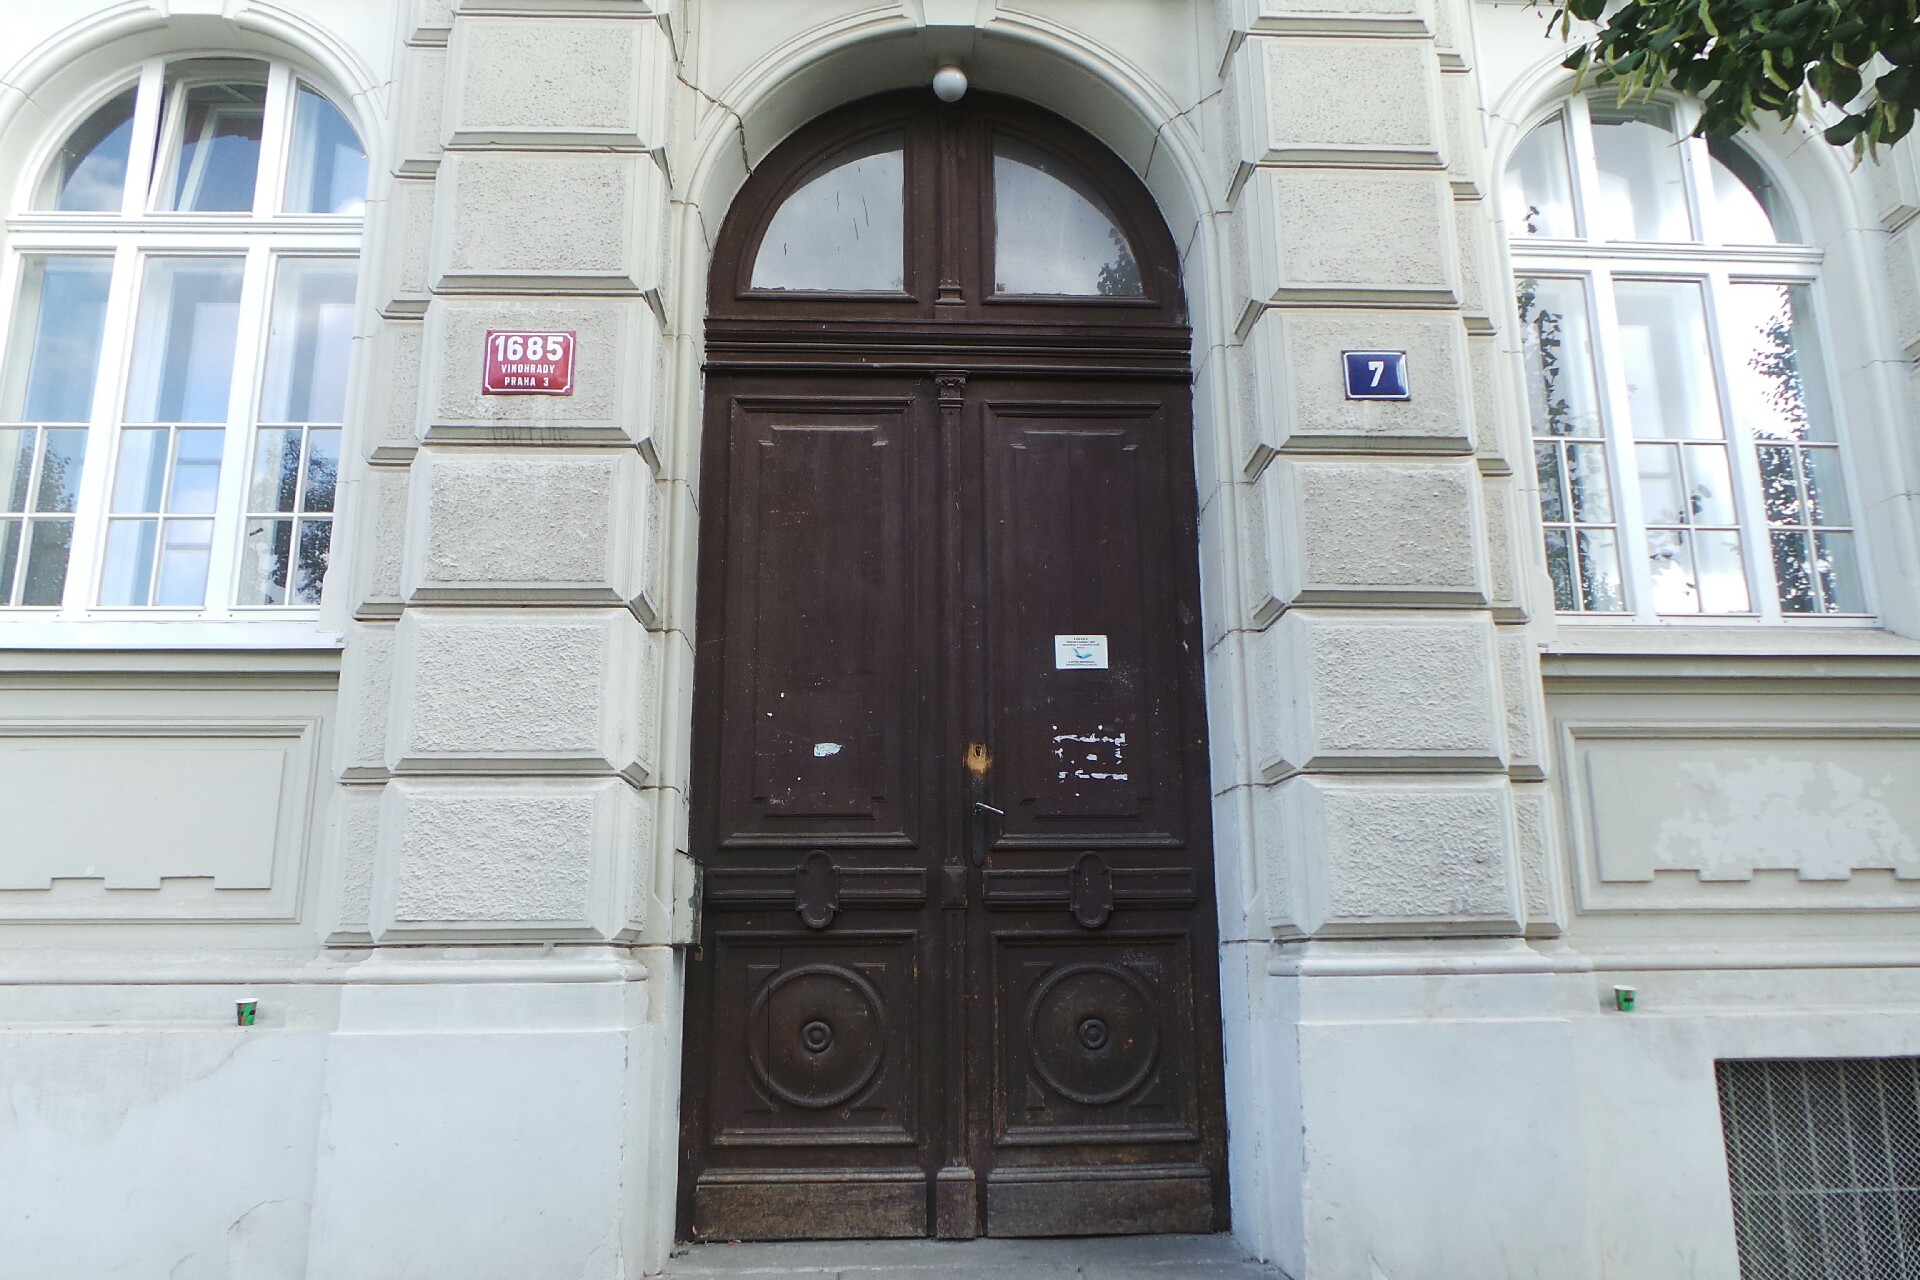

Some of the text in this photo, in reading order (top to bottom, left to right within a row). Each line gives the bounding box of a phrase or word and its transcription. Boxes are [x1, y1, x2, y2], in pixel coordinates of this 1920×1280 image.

[495, 335, 564, 362] 1685
[501, 363, 556, 374] VINOHRADY
[1367, 361, 1385, 387] 7
[504, 376, 549, 387] PRAHA 3
